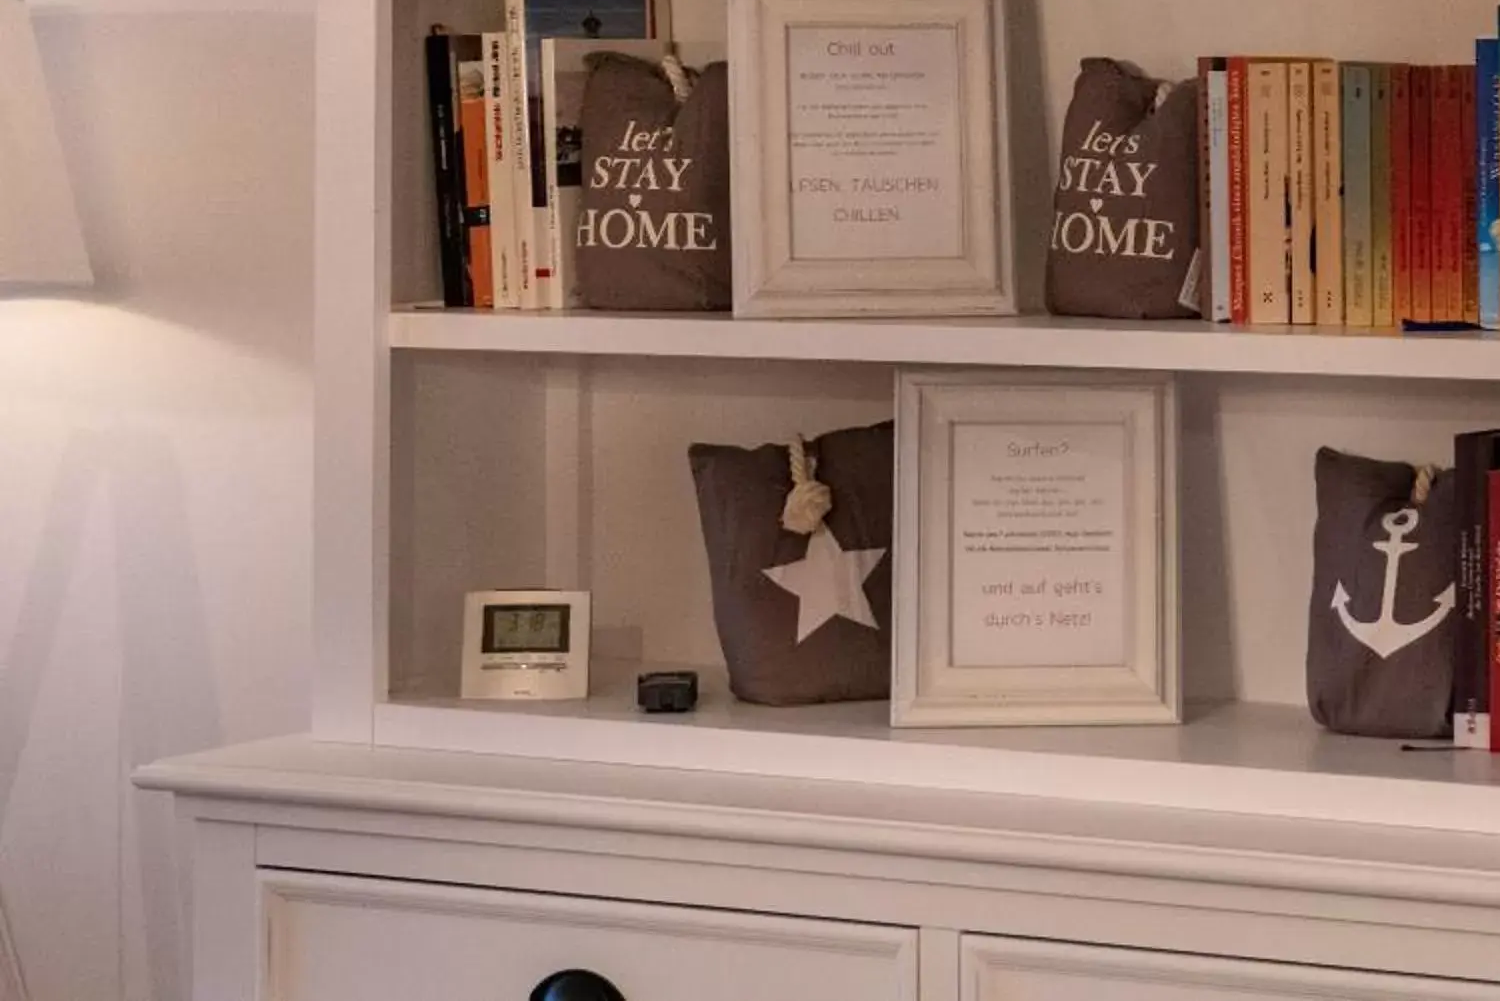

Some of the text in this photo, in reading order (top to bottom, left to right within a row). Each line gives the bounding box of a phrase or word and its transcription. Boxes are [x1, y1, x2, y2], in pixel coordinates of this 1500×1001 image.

[827, 41, 896, 57] Chill out
[590, 156, 693, 192] STAY
[1059, 154, 1158, 198] STAY
[577, 208, 717, 251] HOME
[1006, 441, 1070, 458] Surfen?
[982, 581, 1014, 596] und
[1020, 578, 1047, 596] auf
